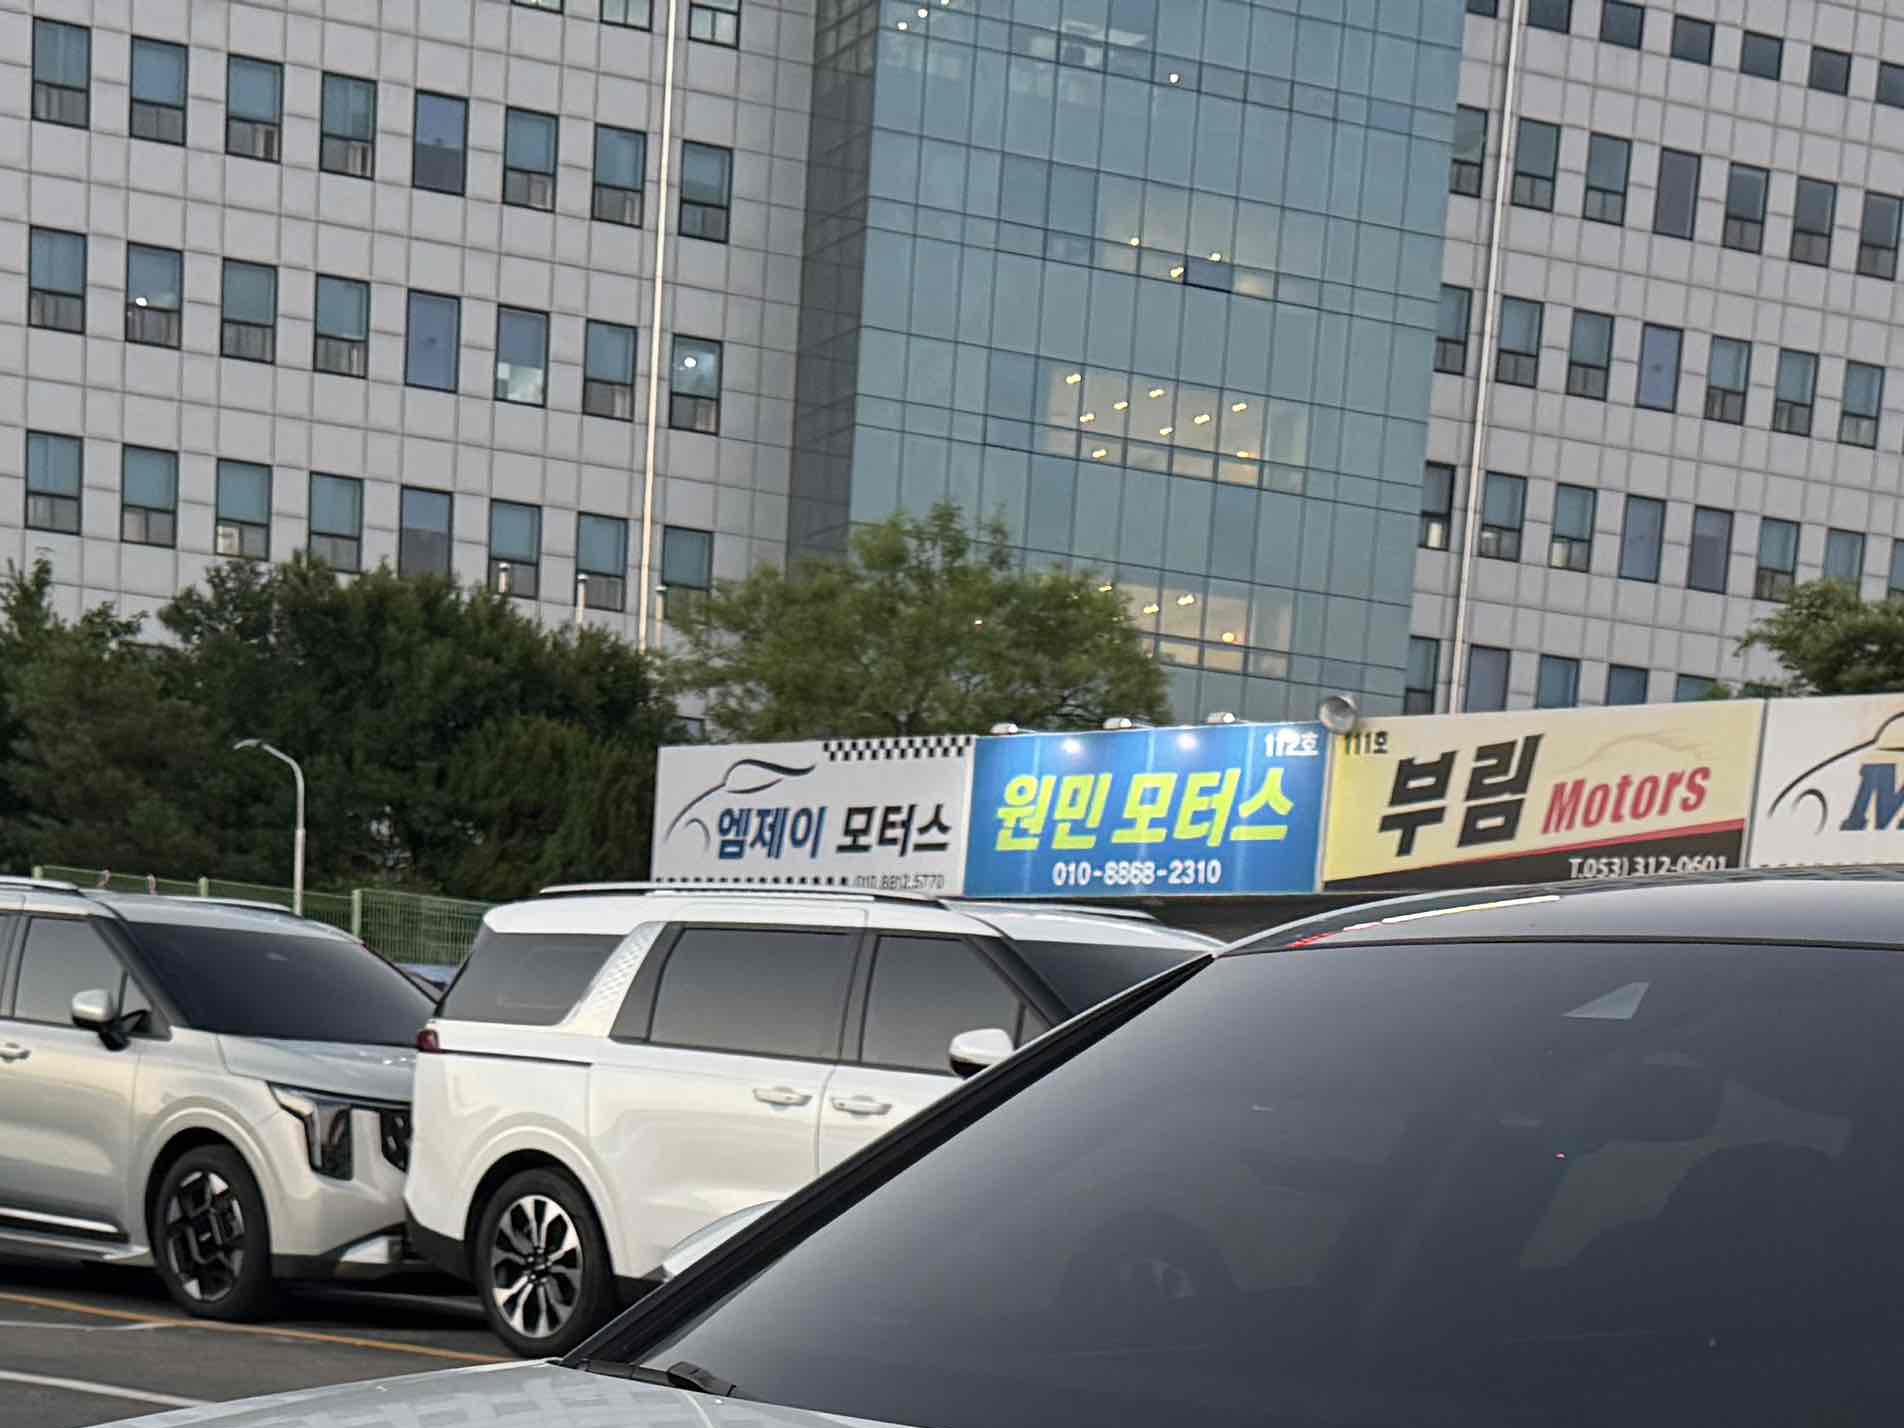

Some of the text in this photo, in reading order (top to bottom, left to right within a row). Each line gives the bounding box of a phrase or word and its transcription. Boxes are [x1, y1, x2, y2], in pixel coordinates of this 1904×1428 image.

[718, 803, 951, 859] 엠제이 모터스
[995, 768, 1294, 851] 원민 모터스
[1379, 733, 1711, 857] 부림 Motors
